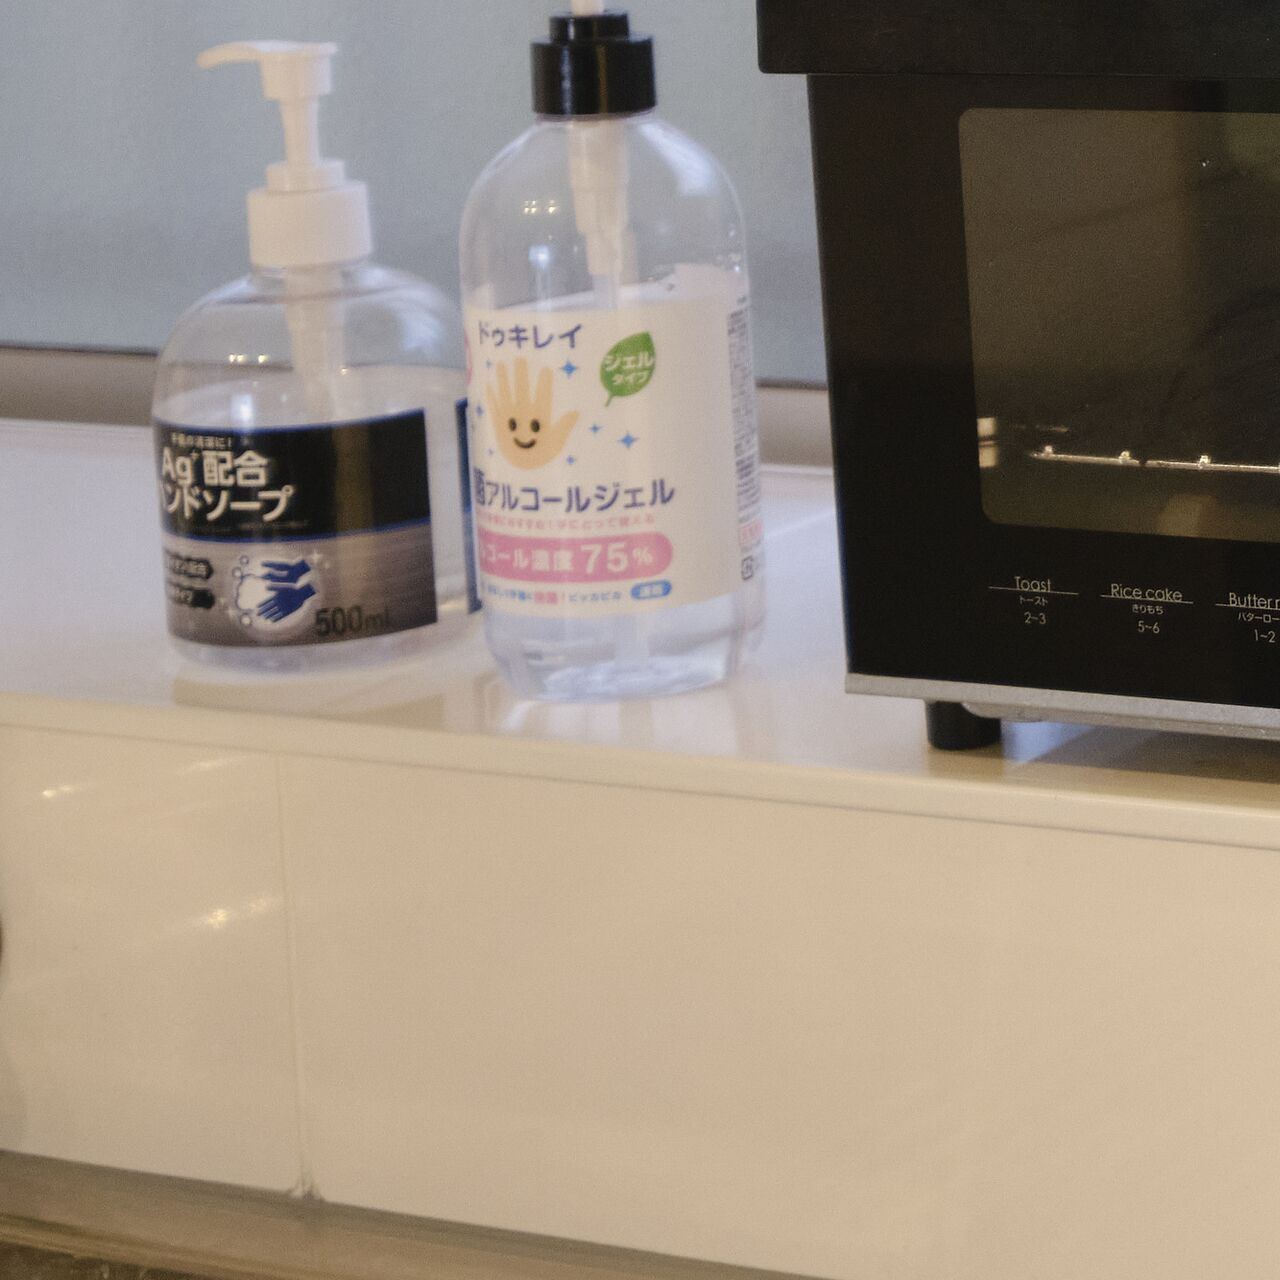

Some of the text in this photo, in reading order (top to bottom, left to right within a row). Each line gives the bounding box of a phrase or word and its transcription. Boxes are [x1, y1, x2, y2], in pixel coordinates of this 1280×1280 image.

[1014, 576, 1052, 592] Toast
[1019, 595, 1048, 606] トースト
[1111, 583, 1183, 603] Rice cake
[1228, 592, 1272, 610] Butter
[1132, 604, 1164, 616] きりもち
